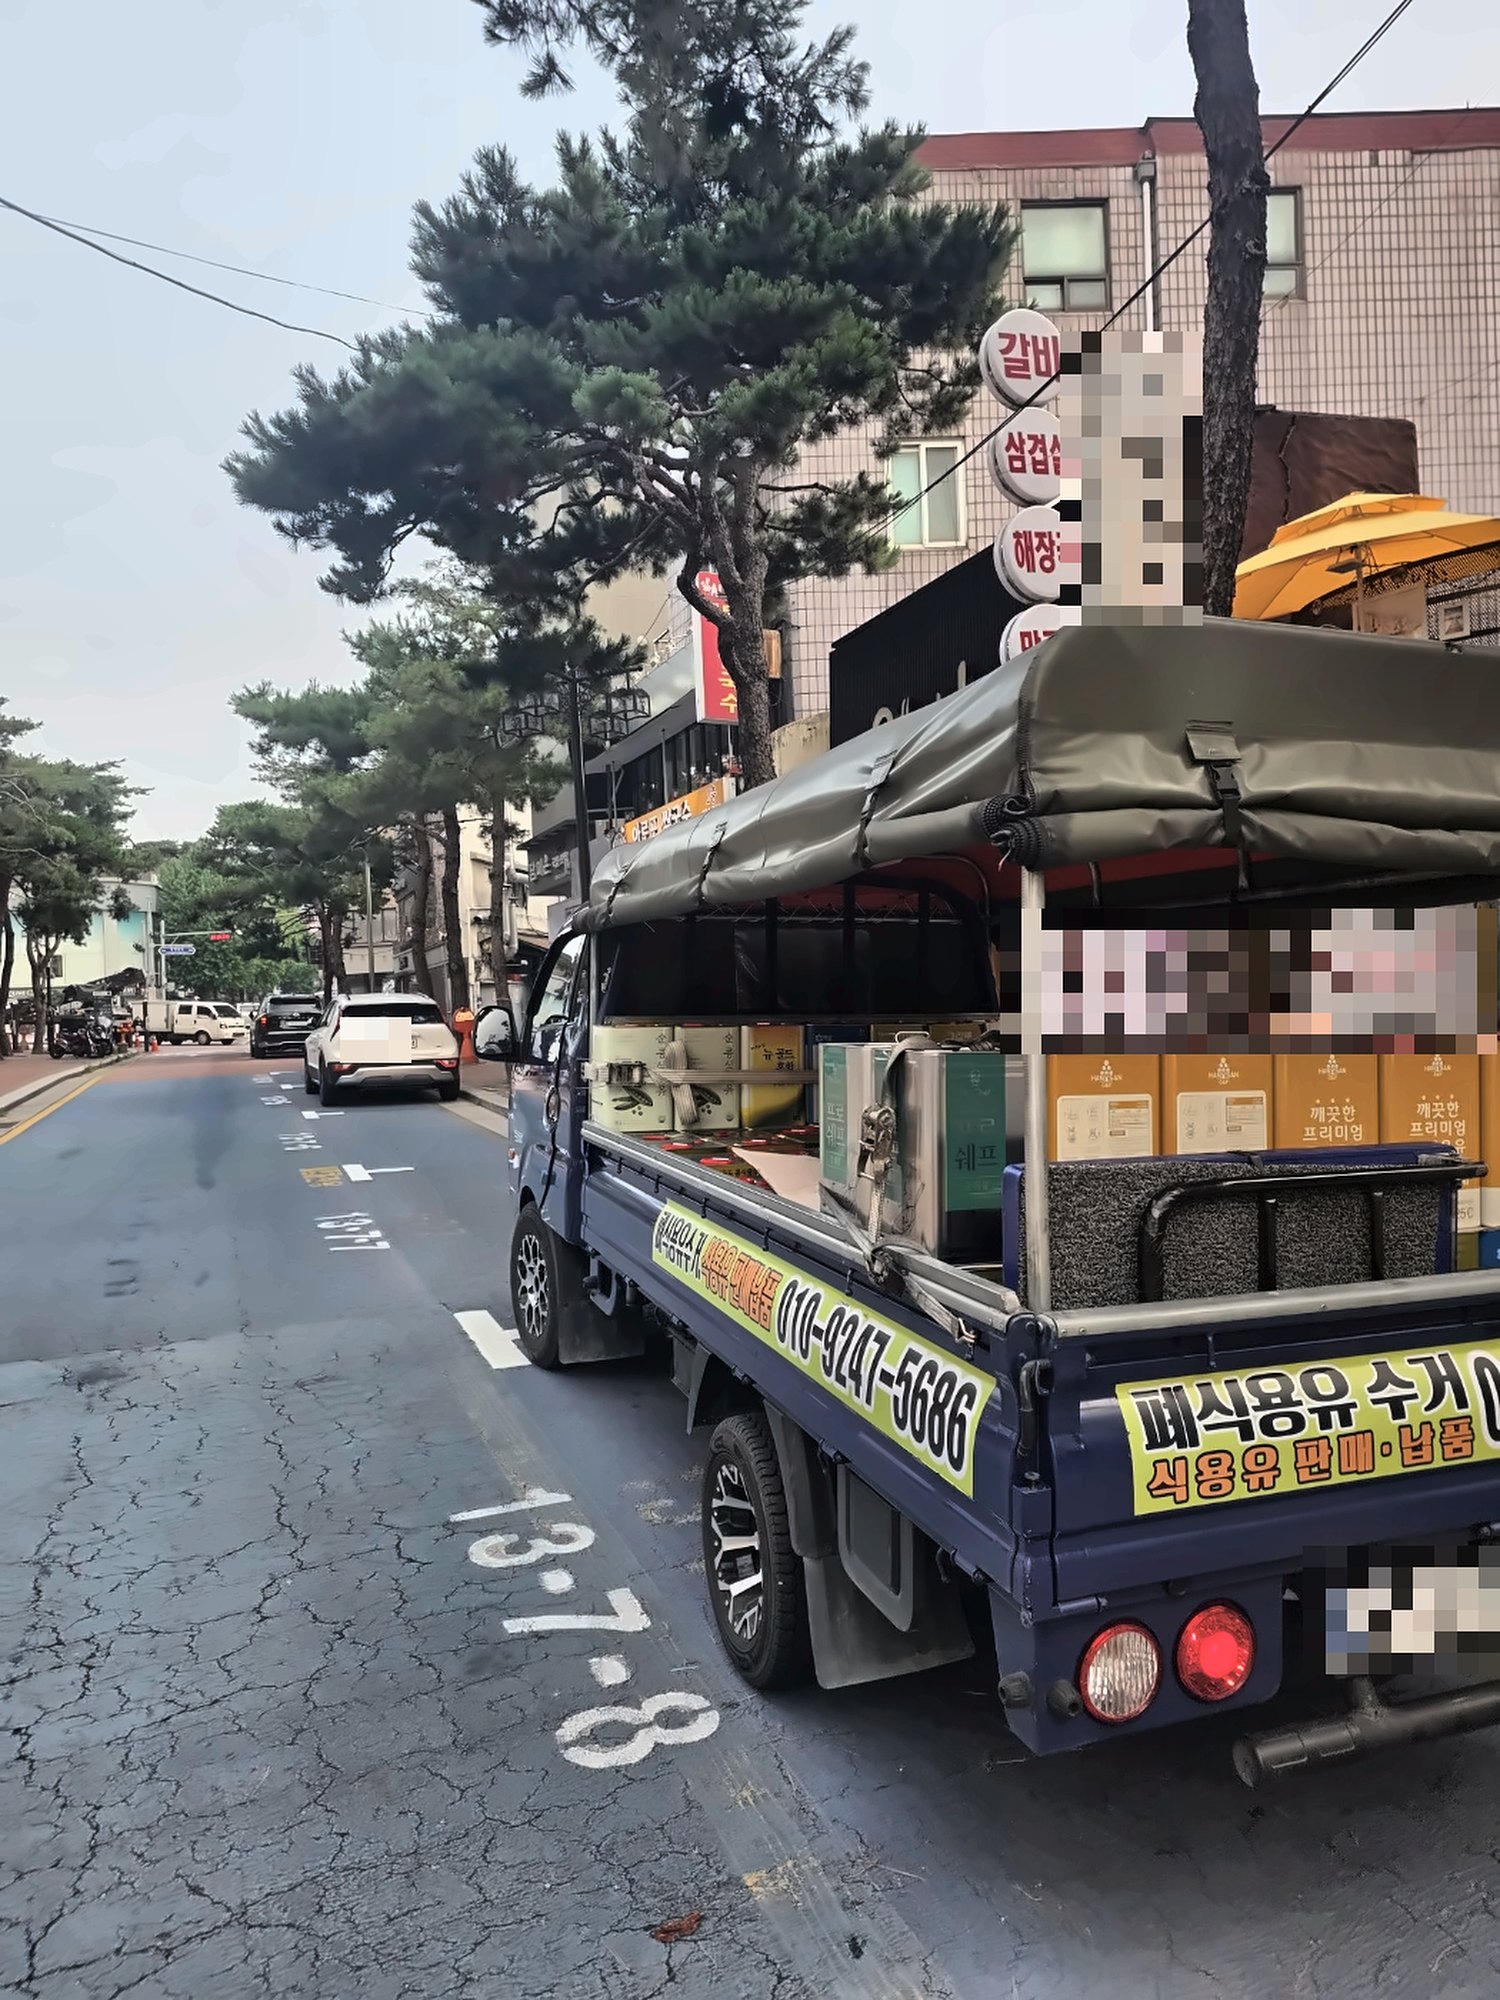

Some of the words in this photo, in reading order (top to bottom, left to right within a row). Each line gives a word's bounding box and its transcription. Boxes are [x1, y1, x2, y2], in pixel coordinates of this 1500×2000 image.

[998, 332, 1060, 382] 갈비
[1012, 530, 1060, 574] 해장
[1310, 1105, 1356, 1123] 깨끗한
[1409, 1119, 1466, 1137] 프리미엄
[1416, 1101, 1460, 1119] 깨끗한
[1302, 1124, 1363, 1142] 프리미엄
[954, 1142, 1000, 1172] 쉐프
[776, 1279, 978, 1472] 010-9247-5686
[1131, 1368, 1358, 1452] 폐식용유
[1369, 1352, 1469, 1421] 수거
[1146, 1447, 1281, 1503] 식용유
